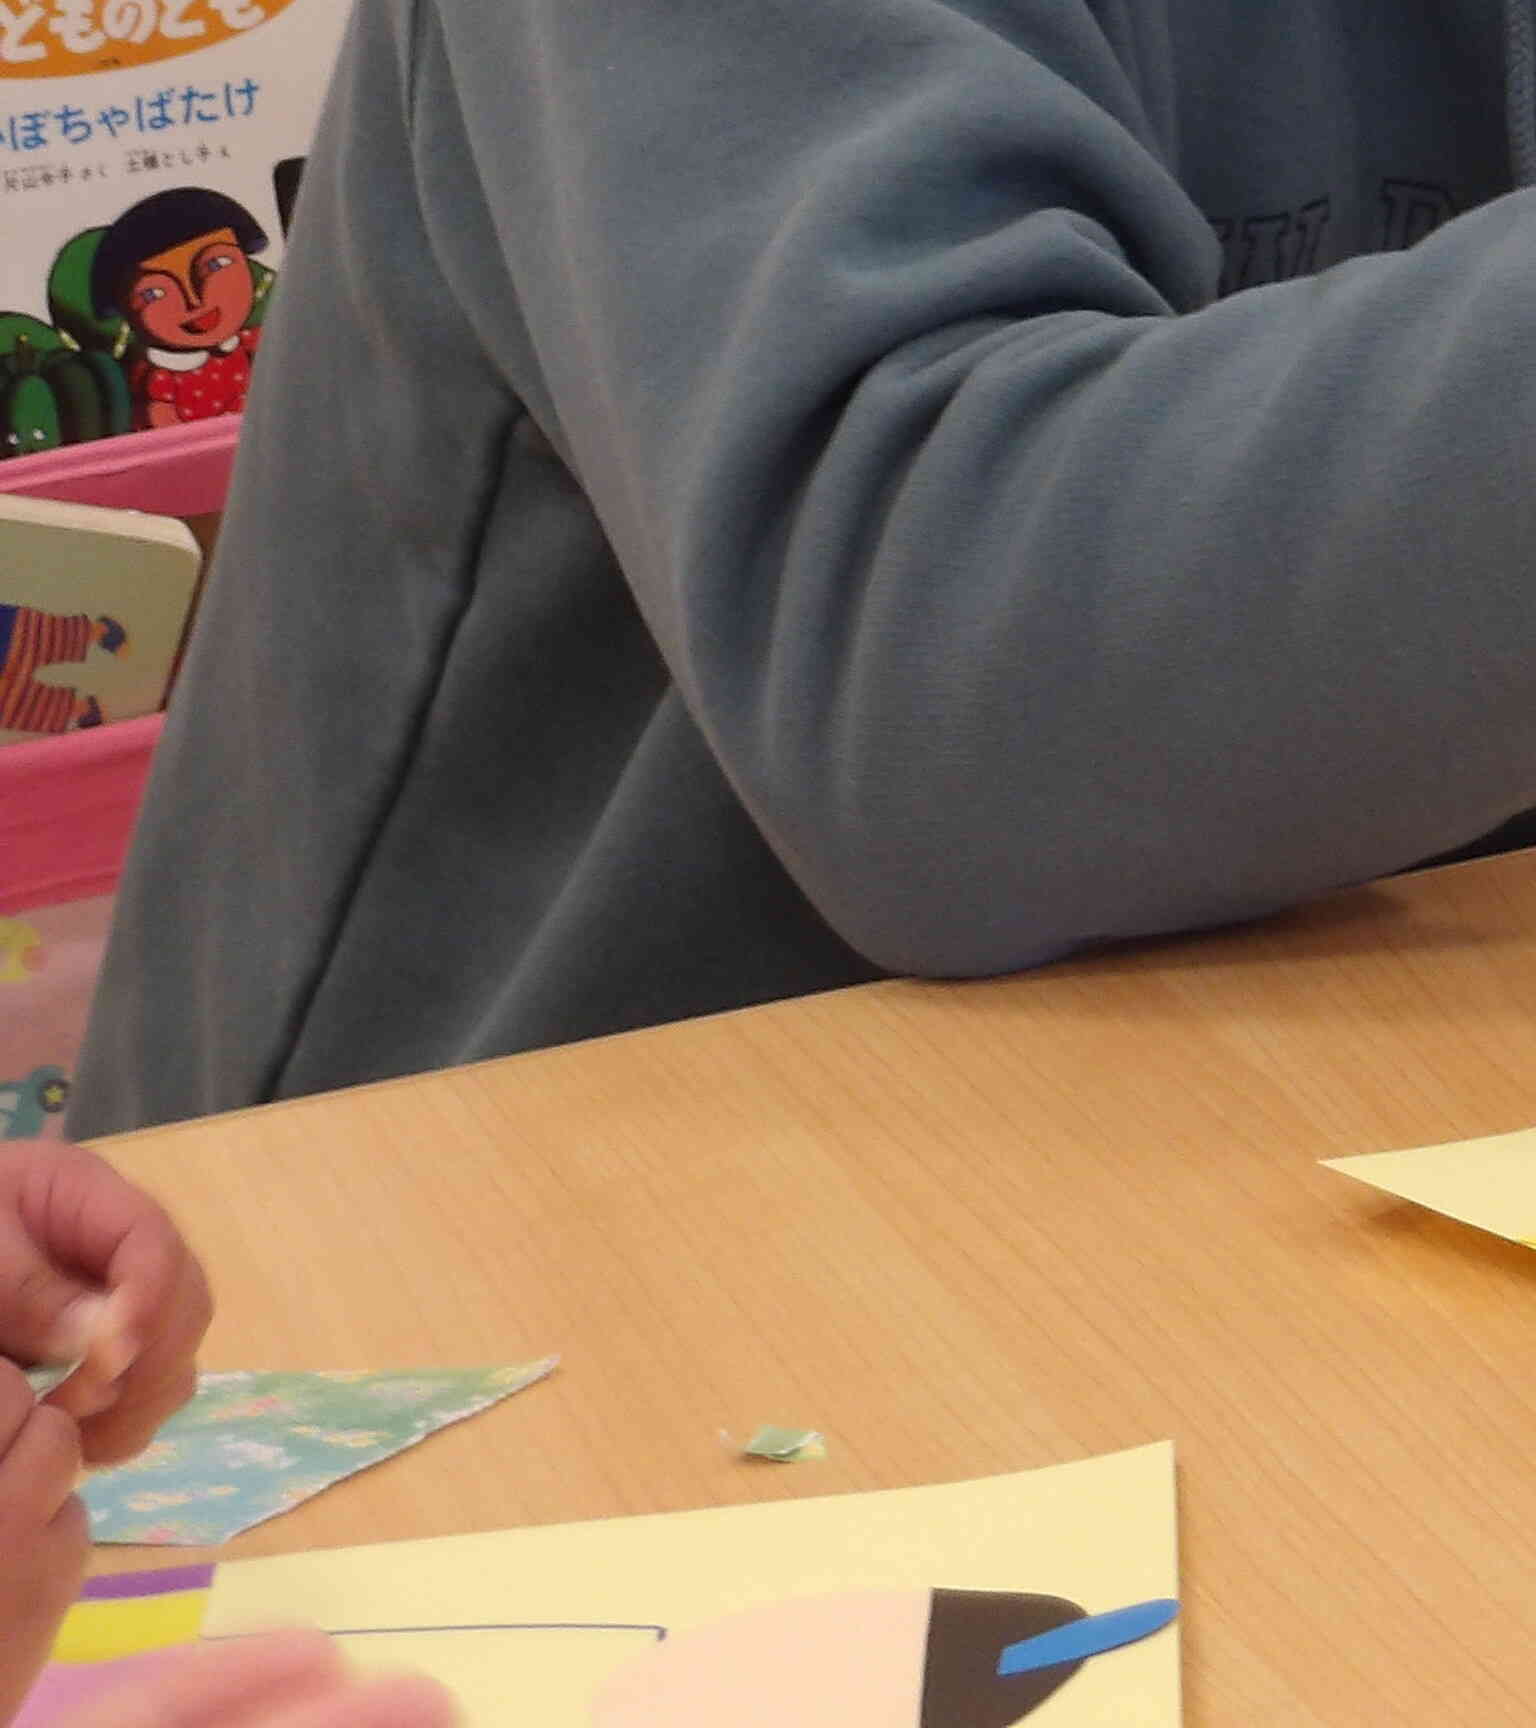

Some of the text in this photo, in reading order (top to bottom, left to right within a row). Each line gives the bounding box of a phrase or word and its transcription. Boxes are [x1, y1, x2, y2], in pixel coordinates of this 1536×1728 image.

[0, 77, 260, 151] ぼちゃばたけ
